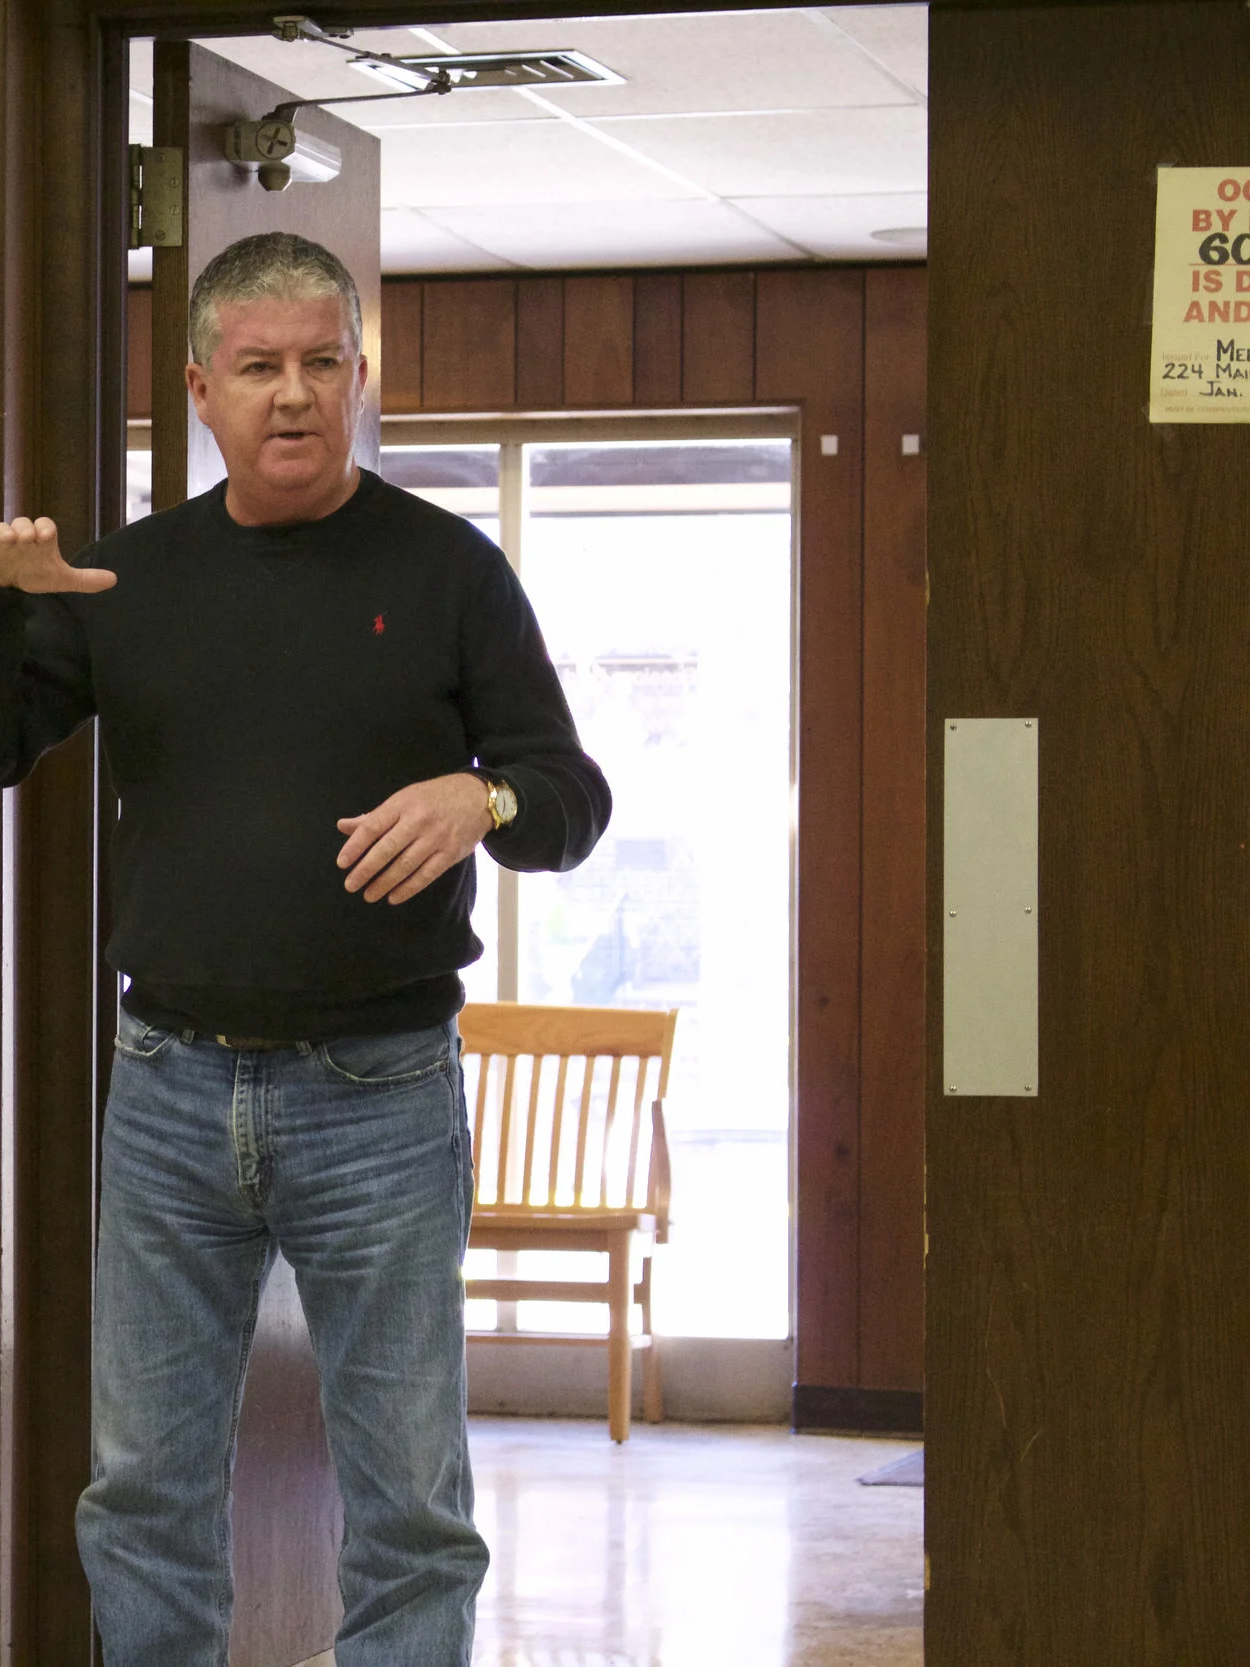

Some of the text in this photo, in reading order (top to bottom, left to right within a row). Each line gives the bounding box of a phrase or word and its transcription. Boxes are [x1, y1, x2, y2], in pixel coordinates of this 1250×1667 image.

[1192, 209, 1237, 232] BY
[1192, 270, 1223, 293] IS
[1183, 300, 1250, 323] AND
[1162, 363, 1204, 380] 224
